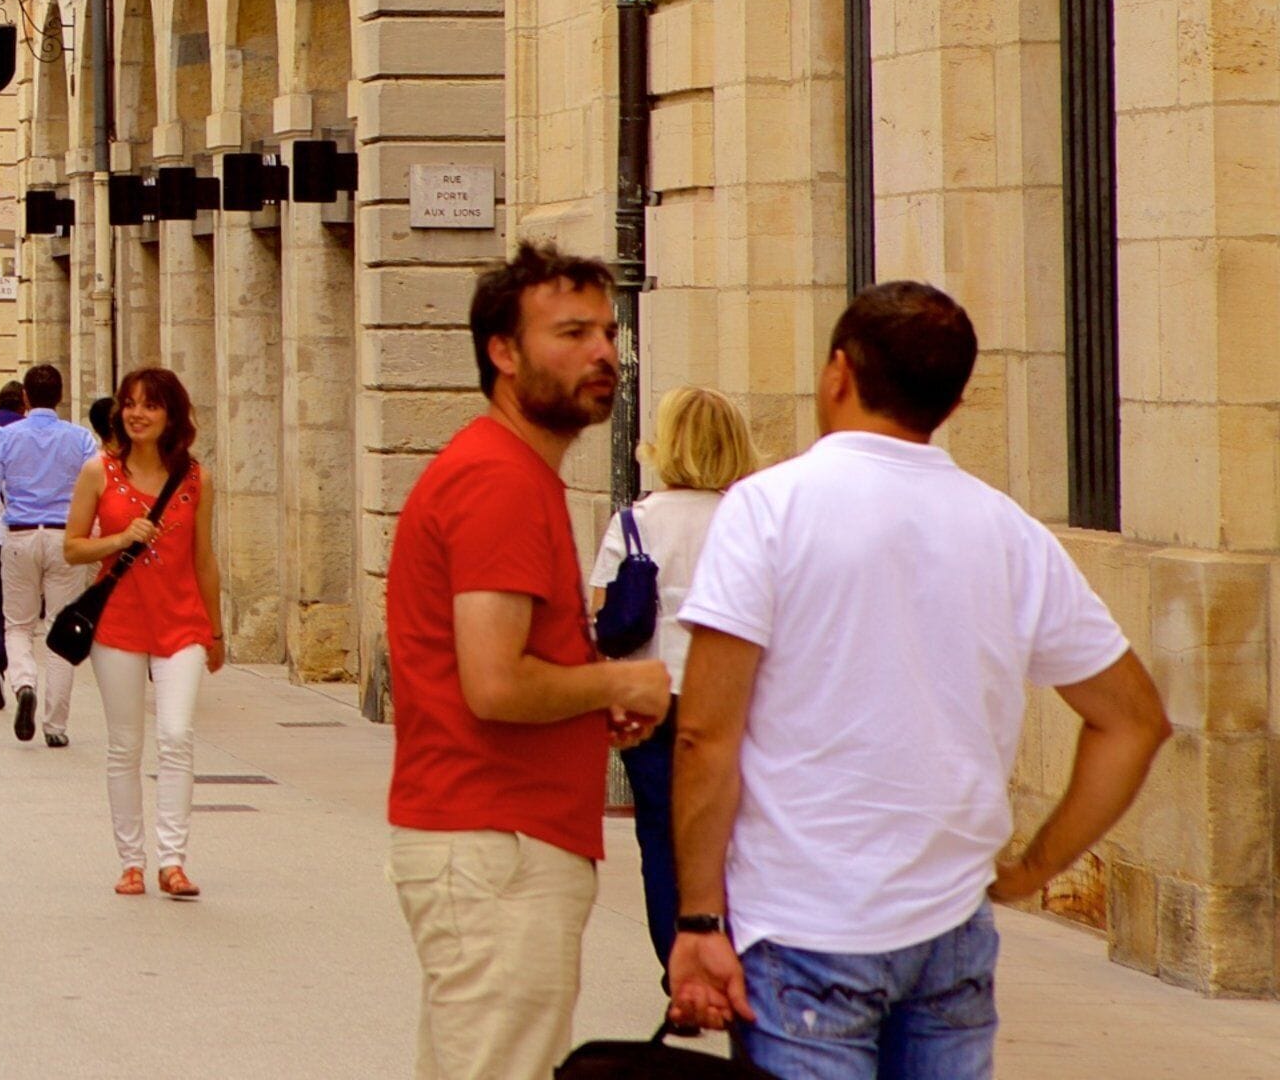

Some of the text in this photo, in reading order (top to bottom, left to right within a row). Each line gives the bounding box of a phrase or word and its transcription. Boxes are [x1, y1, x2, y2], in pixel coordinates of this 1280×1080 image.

[443, 175, 461, 184] RUE
[437, 192, 468, 201] PORTE
[424, 208, 481, 217] AUX LIONS
